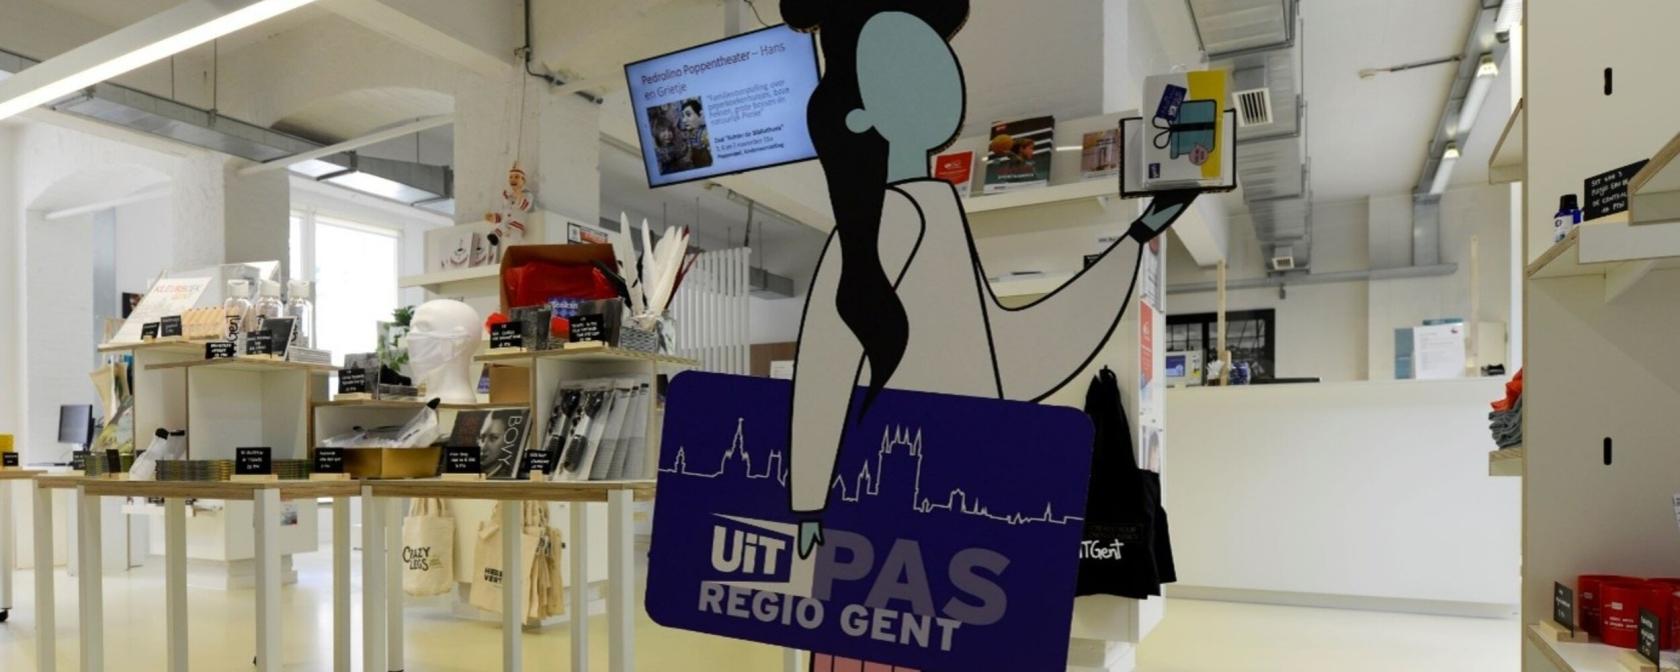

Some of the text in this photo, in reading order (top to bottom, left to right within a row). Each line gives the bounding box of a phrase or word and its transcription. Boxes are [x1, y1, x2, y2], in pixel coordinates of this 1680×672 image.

[682, 51, 751, 76] Poppentheater
[760, 42, 786, 56] Hans
[656, 83, 687, 99] Grietje
[498, 416, 523, 466] BOVY
[409, 558, 430, 572] LEGS
[711, 524, 1011, 626] UiT PAS
[698, 582, 964, 651] REGIO GENT
